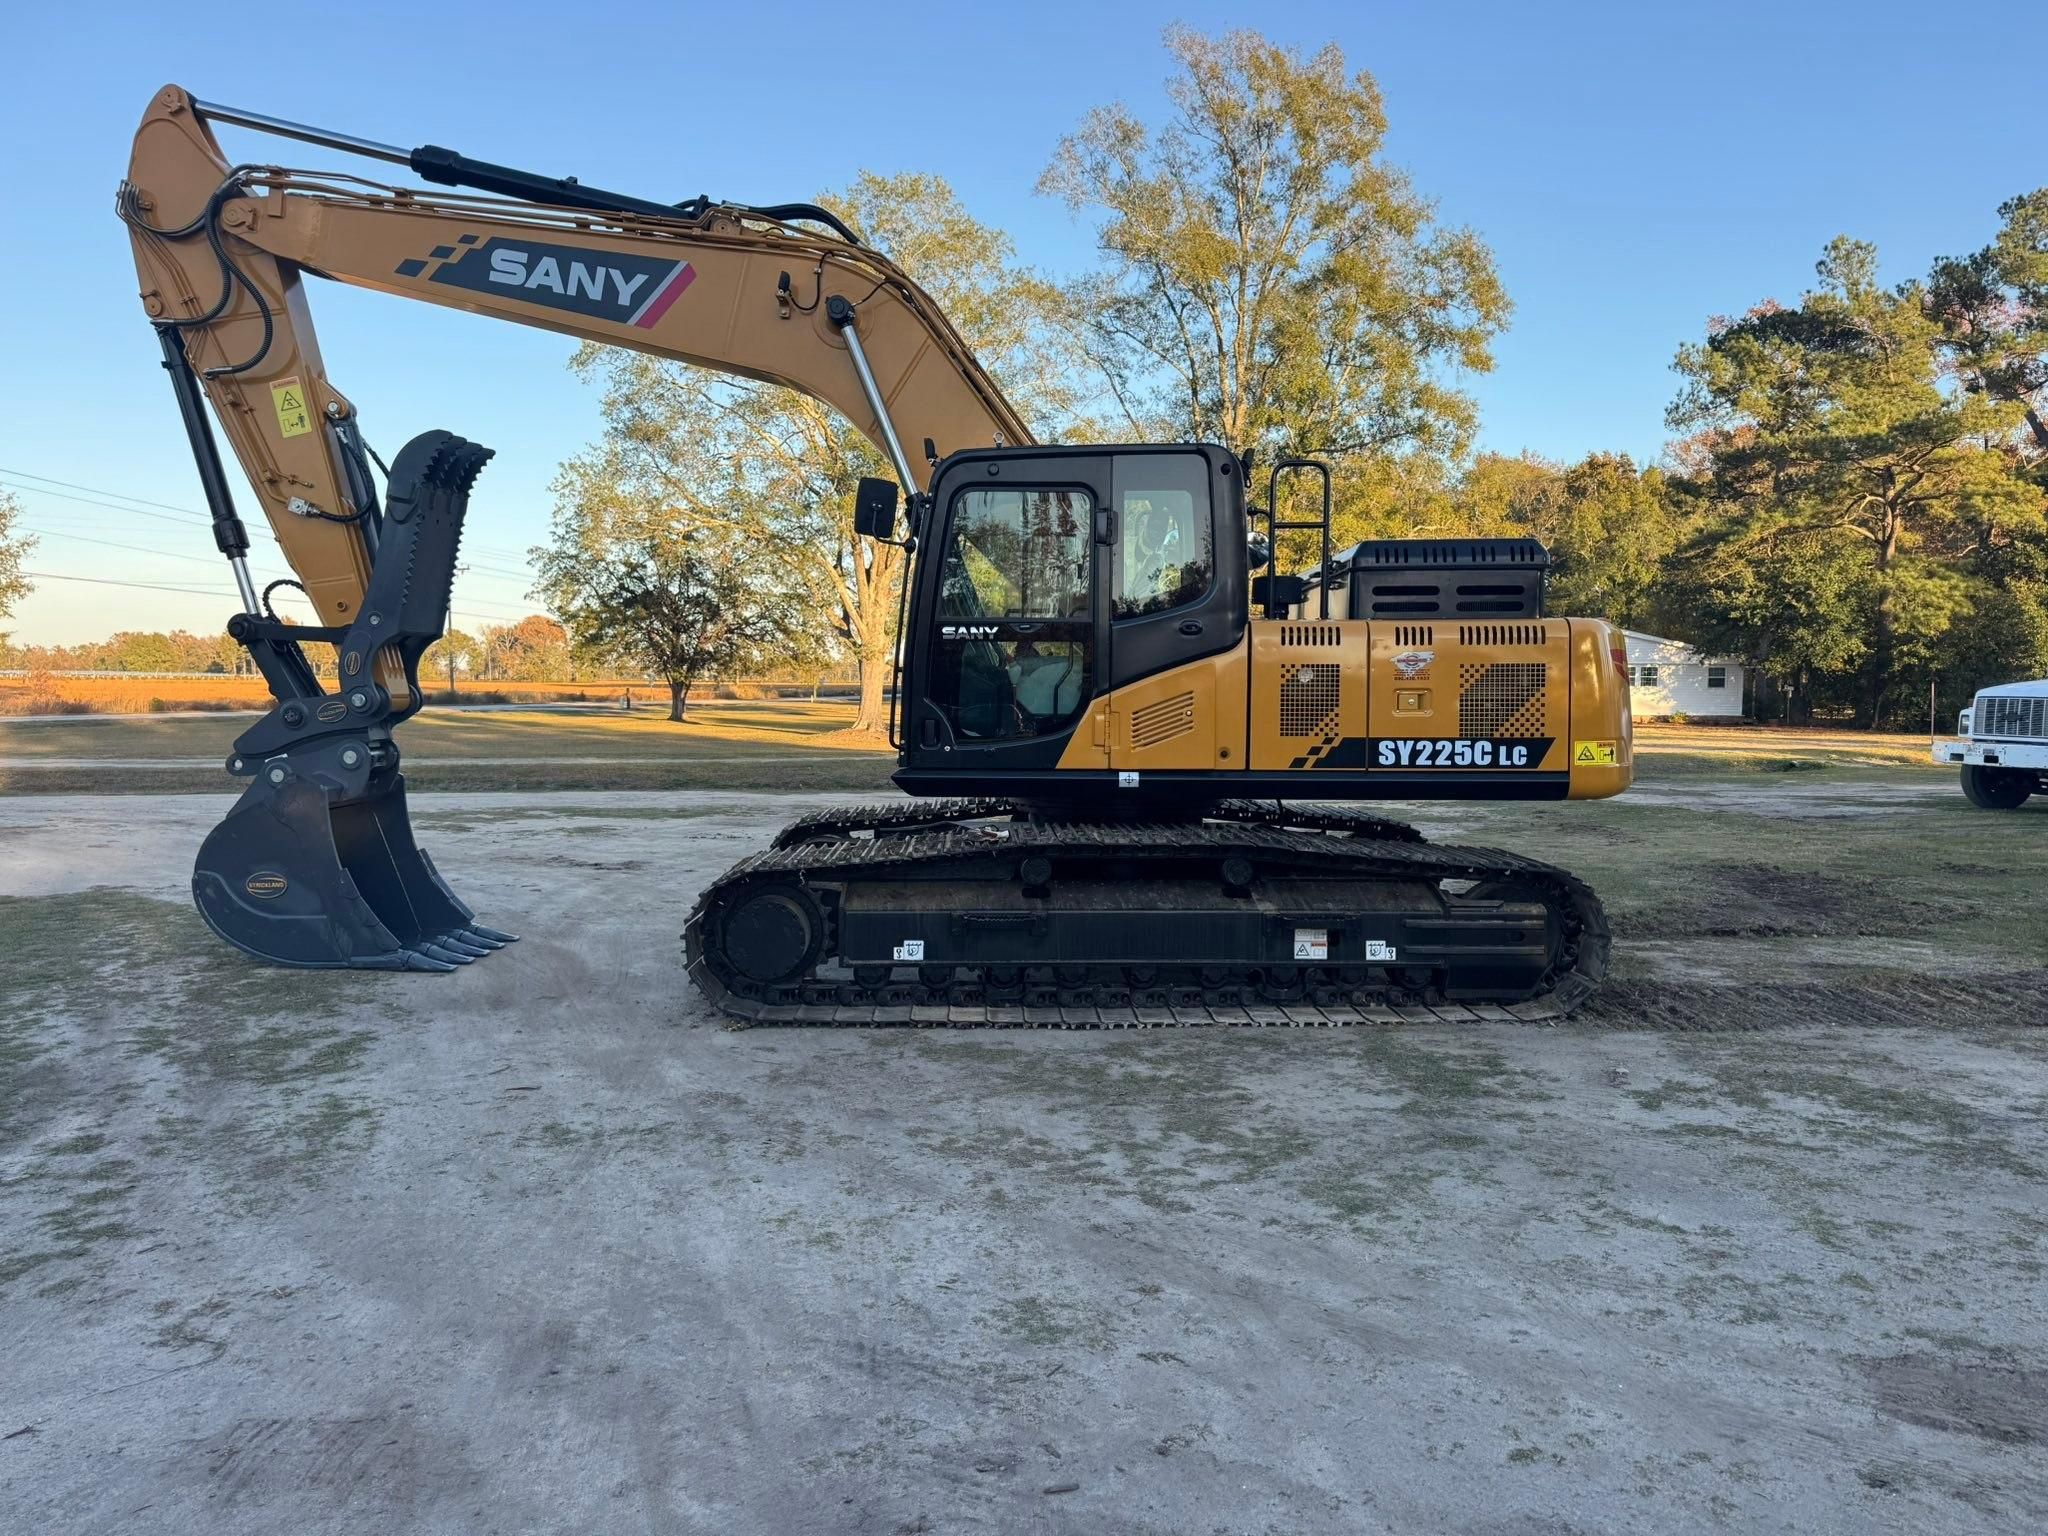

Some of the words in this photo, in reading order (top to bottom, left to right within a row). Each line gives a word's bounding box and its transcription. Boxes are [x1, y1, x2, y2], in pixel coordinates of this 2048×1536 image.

[488, 248, 649, 306] SANY
[942, 626, 999, 639] SANY
[1378, 740, 1492, 766] SY225C
[1499, 745, 1527, 766] LC
